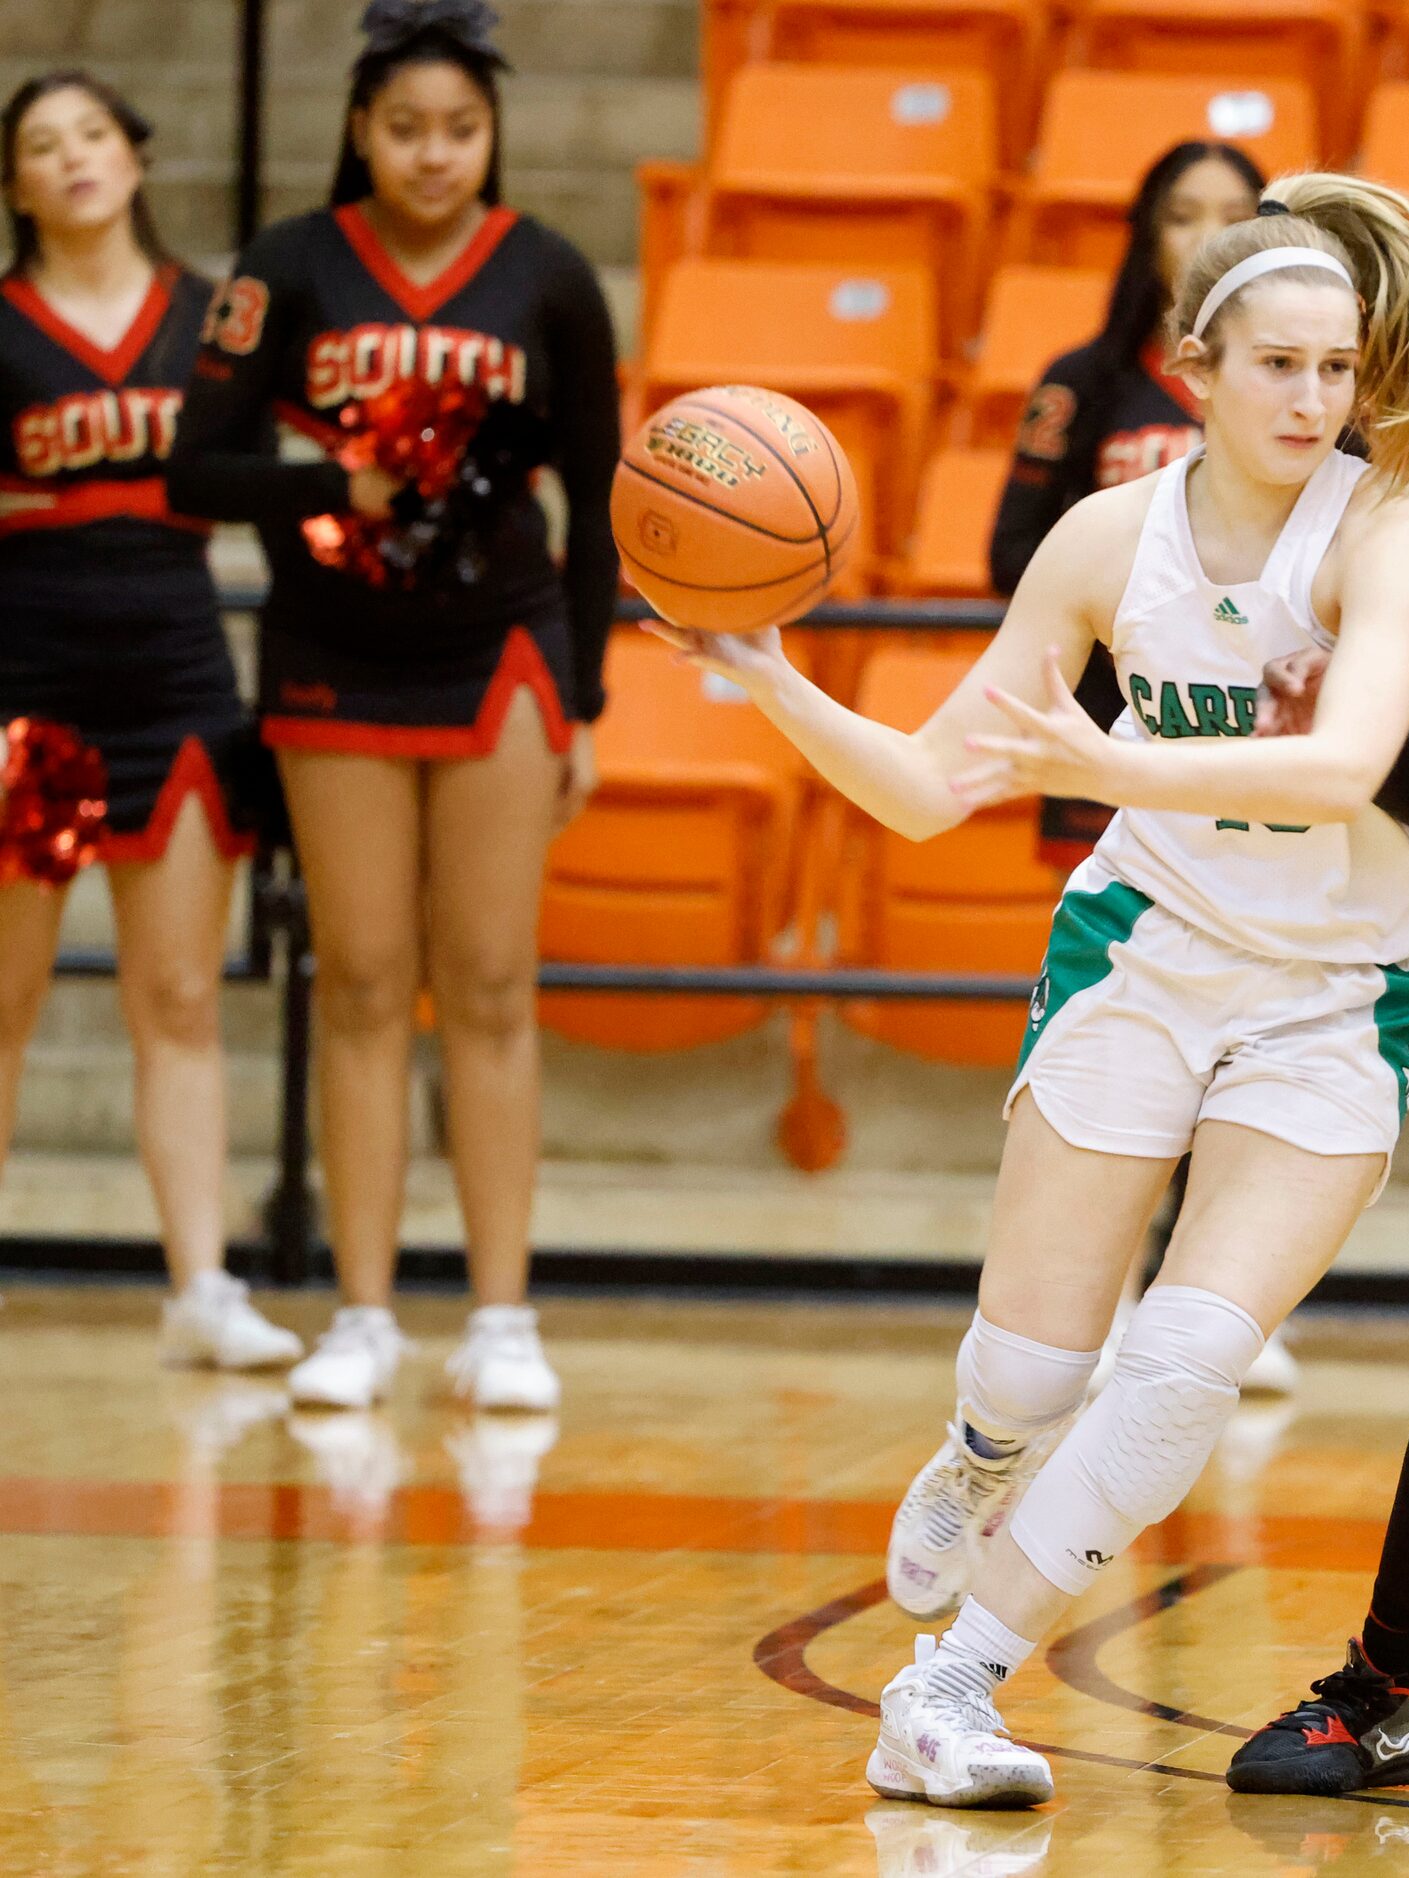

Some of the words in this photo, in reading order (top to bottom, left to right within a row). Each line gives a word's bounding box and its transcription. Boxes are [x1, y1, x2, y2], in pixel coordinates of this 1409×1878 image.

[306, 322, 527, 408] SOUTH
[13, 388, 184, 477] SOUT
[649, 418, 766, 480] EGACY
[1128, 673, 1258, 739] CARR
